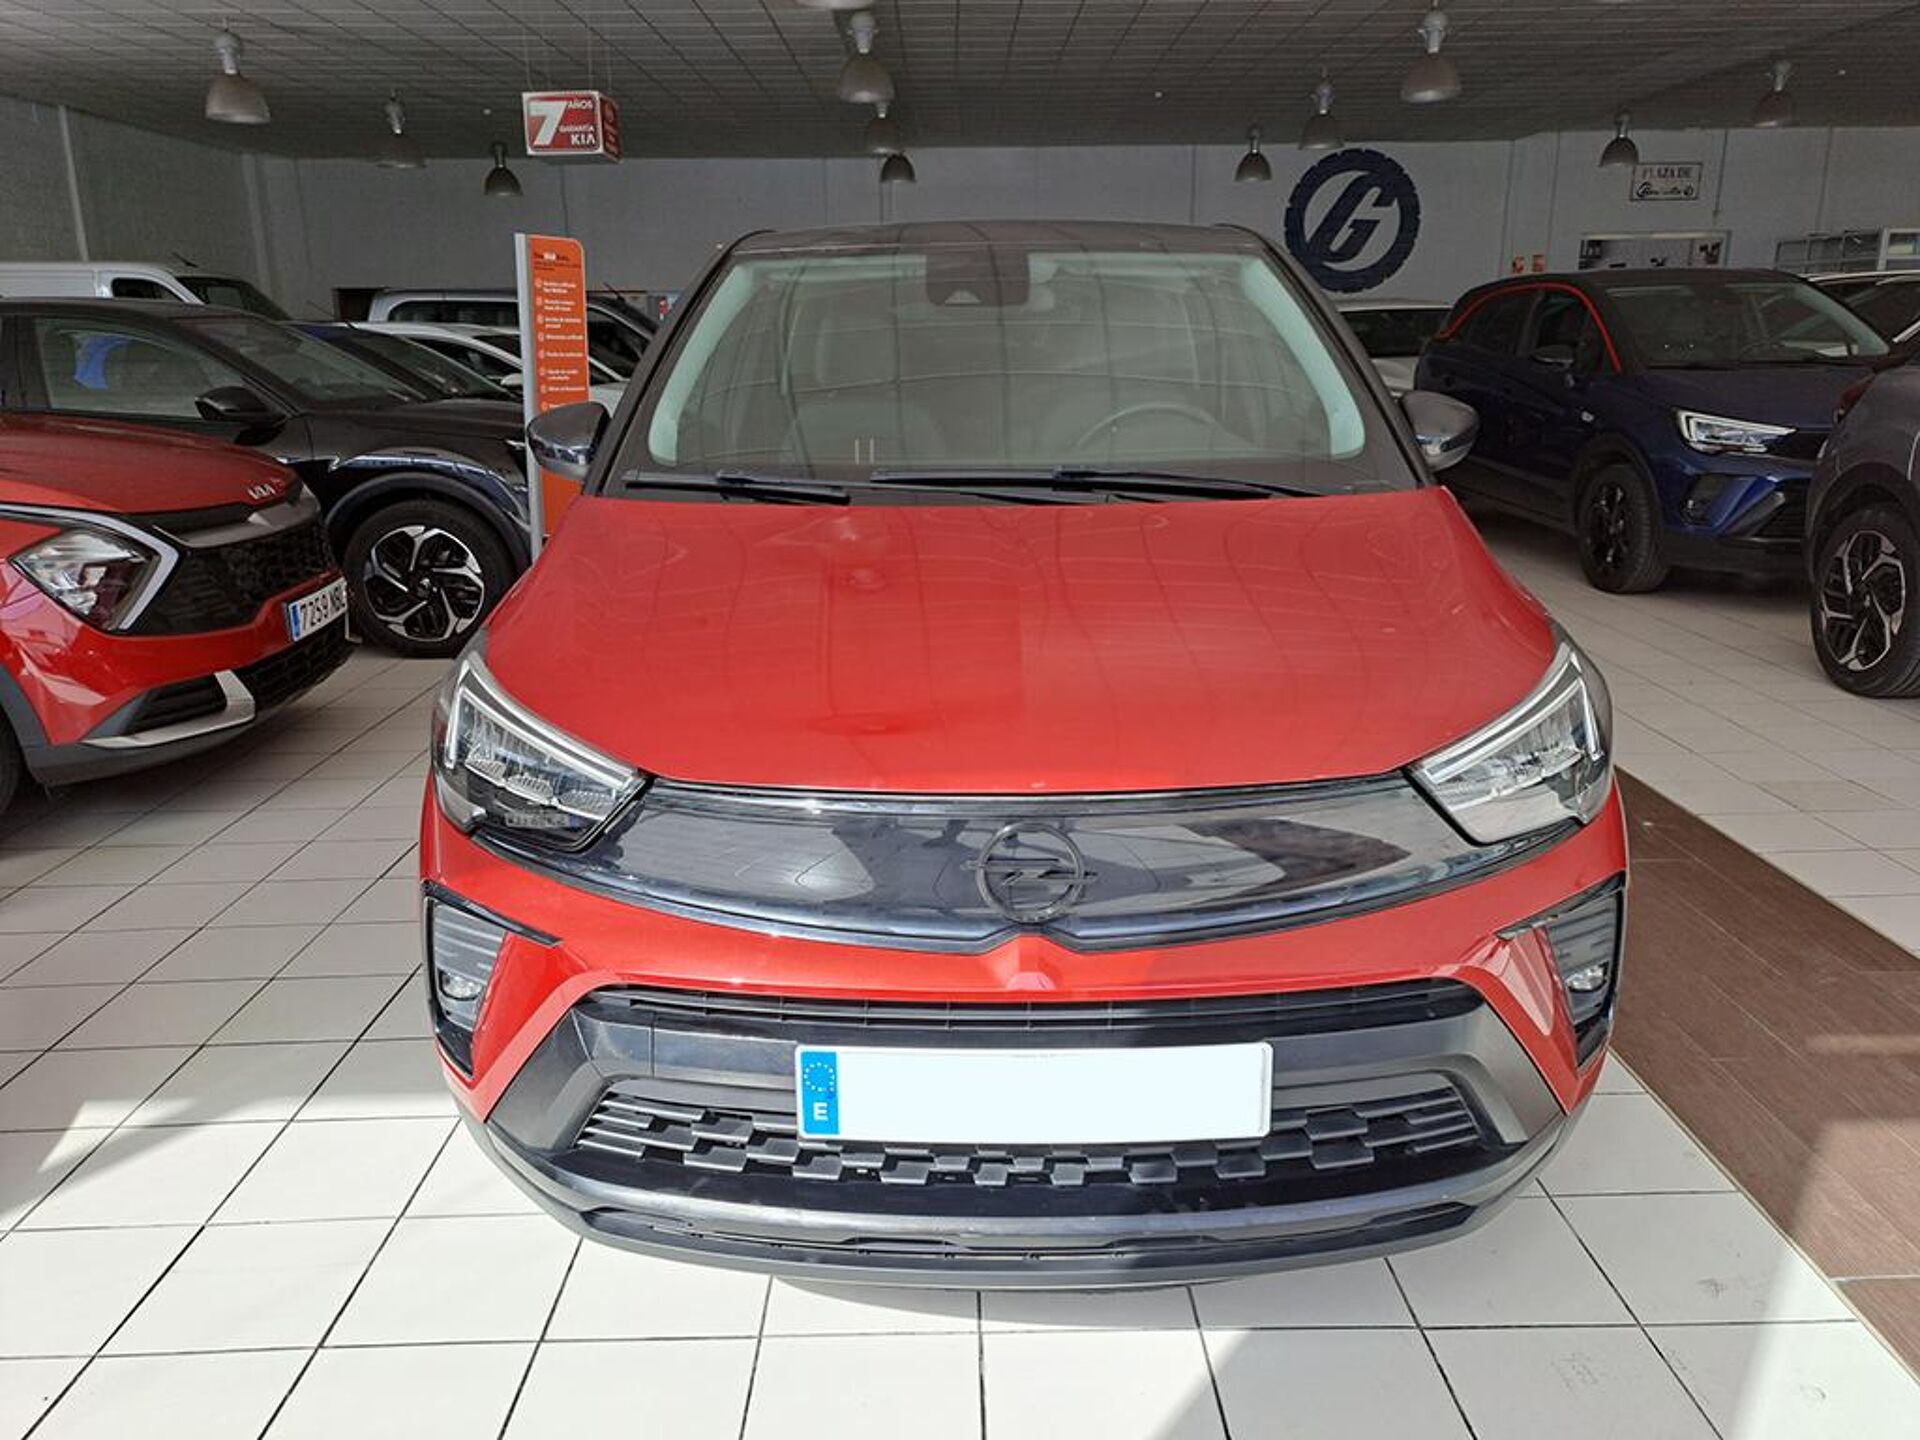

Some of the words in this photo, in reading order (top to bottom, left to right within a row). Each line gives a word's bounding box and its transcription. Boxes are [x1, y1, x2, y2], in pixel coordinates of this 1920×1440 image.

[527, 101, 568, 146] 7
[571, 133, 596, 146] KIA
[813, 1101, 829, 1121] E
